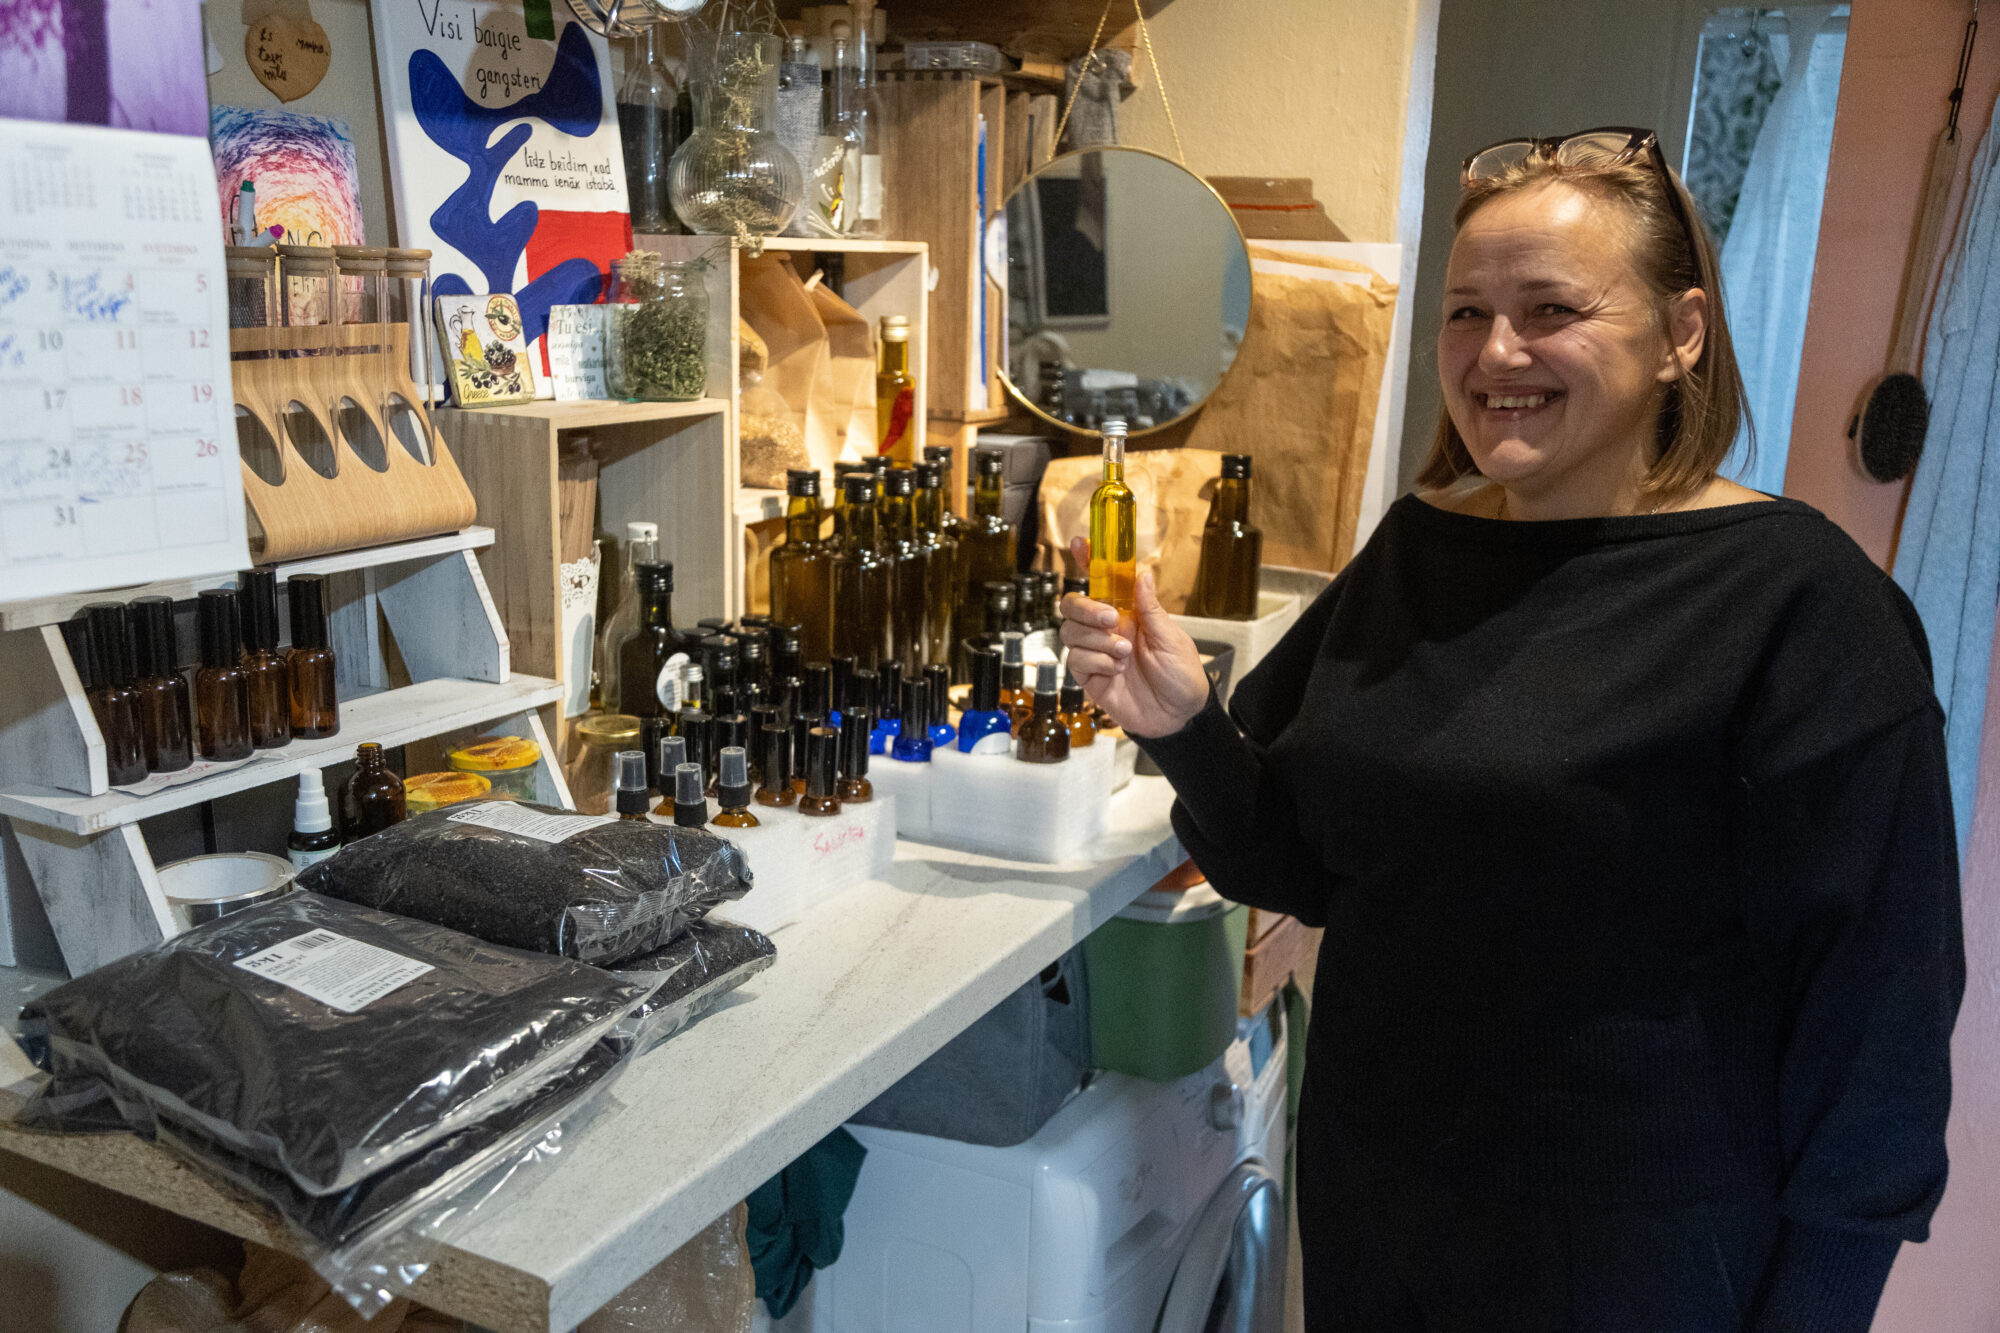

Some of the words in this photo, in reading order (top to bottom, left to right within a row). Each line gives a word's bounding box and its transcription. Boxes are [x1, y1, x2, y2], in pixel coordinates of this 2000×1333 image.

[418, 0, 462, 40] Visi
[476, 68, 541, 98] gangsteri
[524, 147, 546, 169] līdz
[594, 158, 611, 174] kad
[504, 173, 549, 188] mamma
[554, 176, 581, 189] ienāk
[196, 273, 207, 293] 5
[557, 319, 571, 334] Tu
[39, 330, 63, 350] 10
[117, 330, 136, 349] 11
[190, 329, 209, 349] 12
[43, 389, 67, 410] 17
[120, 387, 143, 407] 18
[192, 384, 213, 404] 19
[463, 384, 489, 400] Greece
[48, 448, 71, 469] 24
[124, 443, 147, 463] 25
[196, 440, 218, 458] 26
[55, 506, 76, 527] 31
